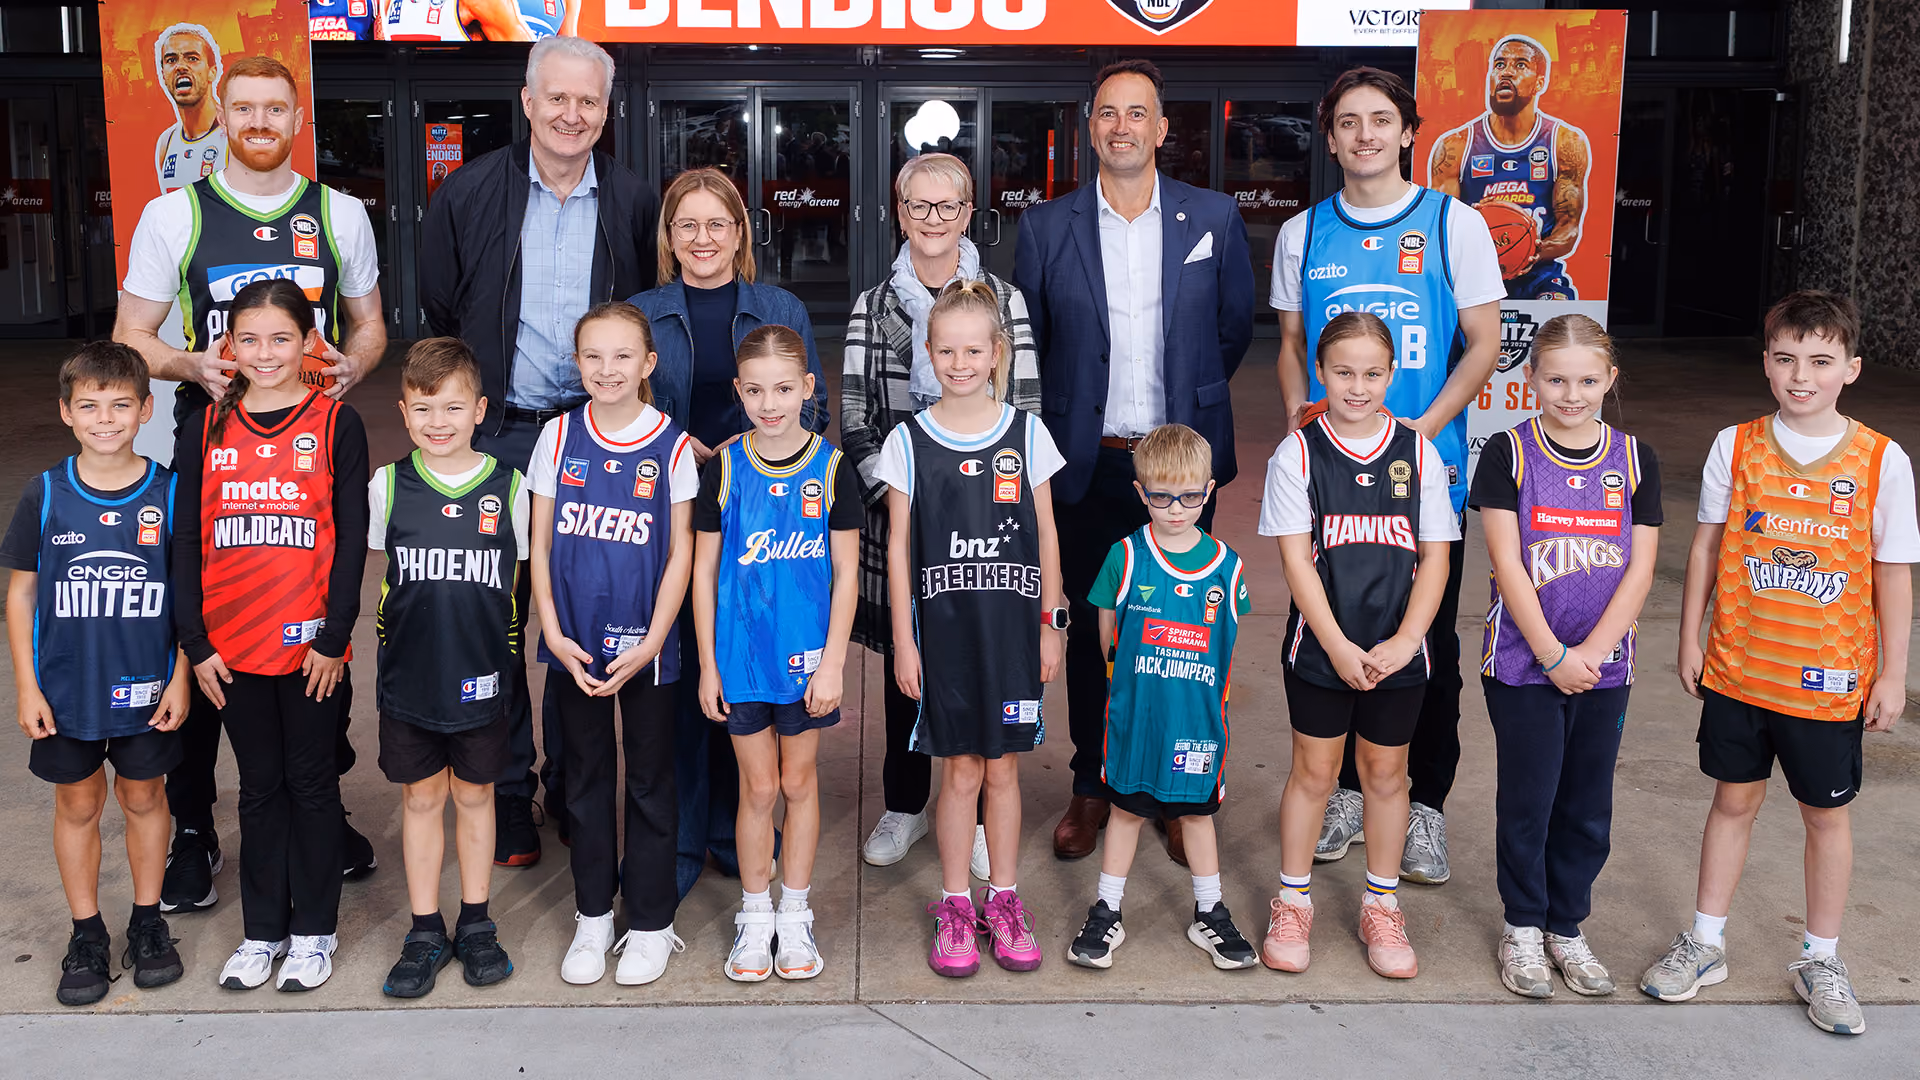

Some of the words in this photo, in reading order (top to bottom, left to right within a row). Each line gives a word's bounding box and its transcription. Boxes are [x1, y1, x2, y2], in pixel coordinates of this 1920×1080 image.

[773, 188, 798, 201] red
[1001, 189, 1024, 201] red
[1234, 189, 1257, 201] red
[1484, 182, 1528, 197] MEGA
[12, 198, 43, 206] arena
[778, 200, 802, 208] energy
[809, 198, 840, 207] arena
[1005, 200, 1029, 208] energy
[1238, 201, 1261, 209] energy
[1268, 199, 1299, 207] arena
[1621, 199, 1652, 207] arena
[296, 220, 313, 233] NBL
[1403, 236, 1422, 249] NBL
[1308, 263, 1348, 280] ozito
[999, 457, 1017, 472] NBL
[1393, 466, 1406, 476] NBL
[222, 477, 307, 501] mate.
[222, 502, 258, 510] internet
[266, 501, 300, 511] mobile
[557, 501, 653, 546] SIXERS
[1537, 512, 1574, 527] Harvey
[1576, 516, 1618, 528] Norman
[1766, 512, 1849, 540] Kenfrost
[51, 531, 86, 545] ozito
[213, 513, 317, 550] WILDCATS
[1322, 514, 1417, 552] HAWKS
[737, 528, 826, 566] Bullets
[949, 531, 1000, 558] bnz
[395, 546, 502, 589] PHOENIX
[1528, 537, 1624, 591] KINGS
[921, 562, 1041, 599] BREAKERS
[1743, 555, 1849, 604] TAIPANS
[55, 580, 165, 618] UNITED
[1168, 627, 1196, 638] SPIRIT
[1167, 635, 1207, 648] TASMANIA
[1155, 646, 1200, 661] TASMANIA
